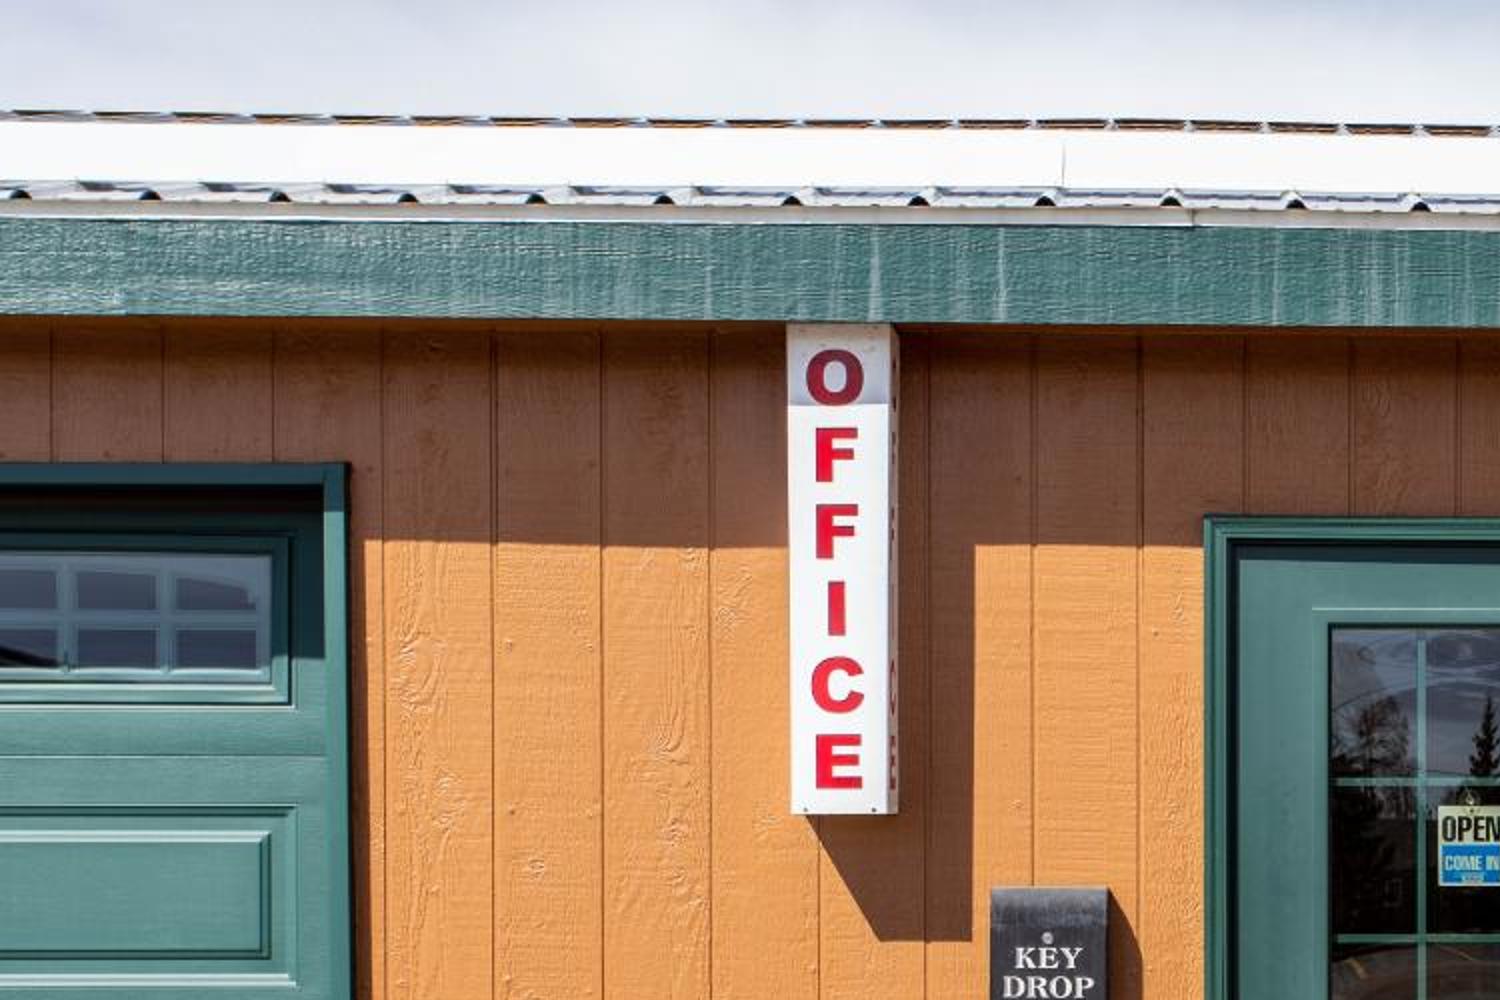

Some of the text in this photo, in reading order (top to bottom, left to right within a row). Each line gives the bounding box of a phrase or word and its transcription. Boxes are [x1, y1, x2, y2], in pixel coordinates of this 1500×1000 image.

[806, 349, 865, 789] OFFICE
[1445, 855, 1500, 871] COME IN
[1014, 947, 1084, 970] KEY
[1002, 975, 1095, 999] DROP
